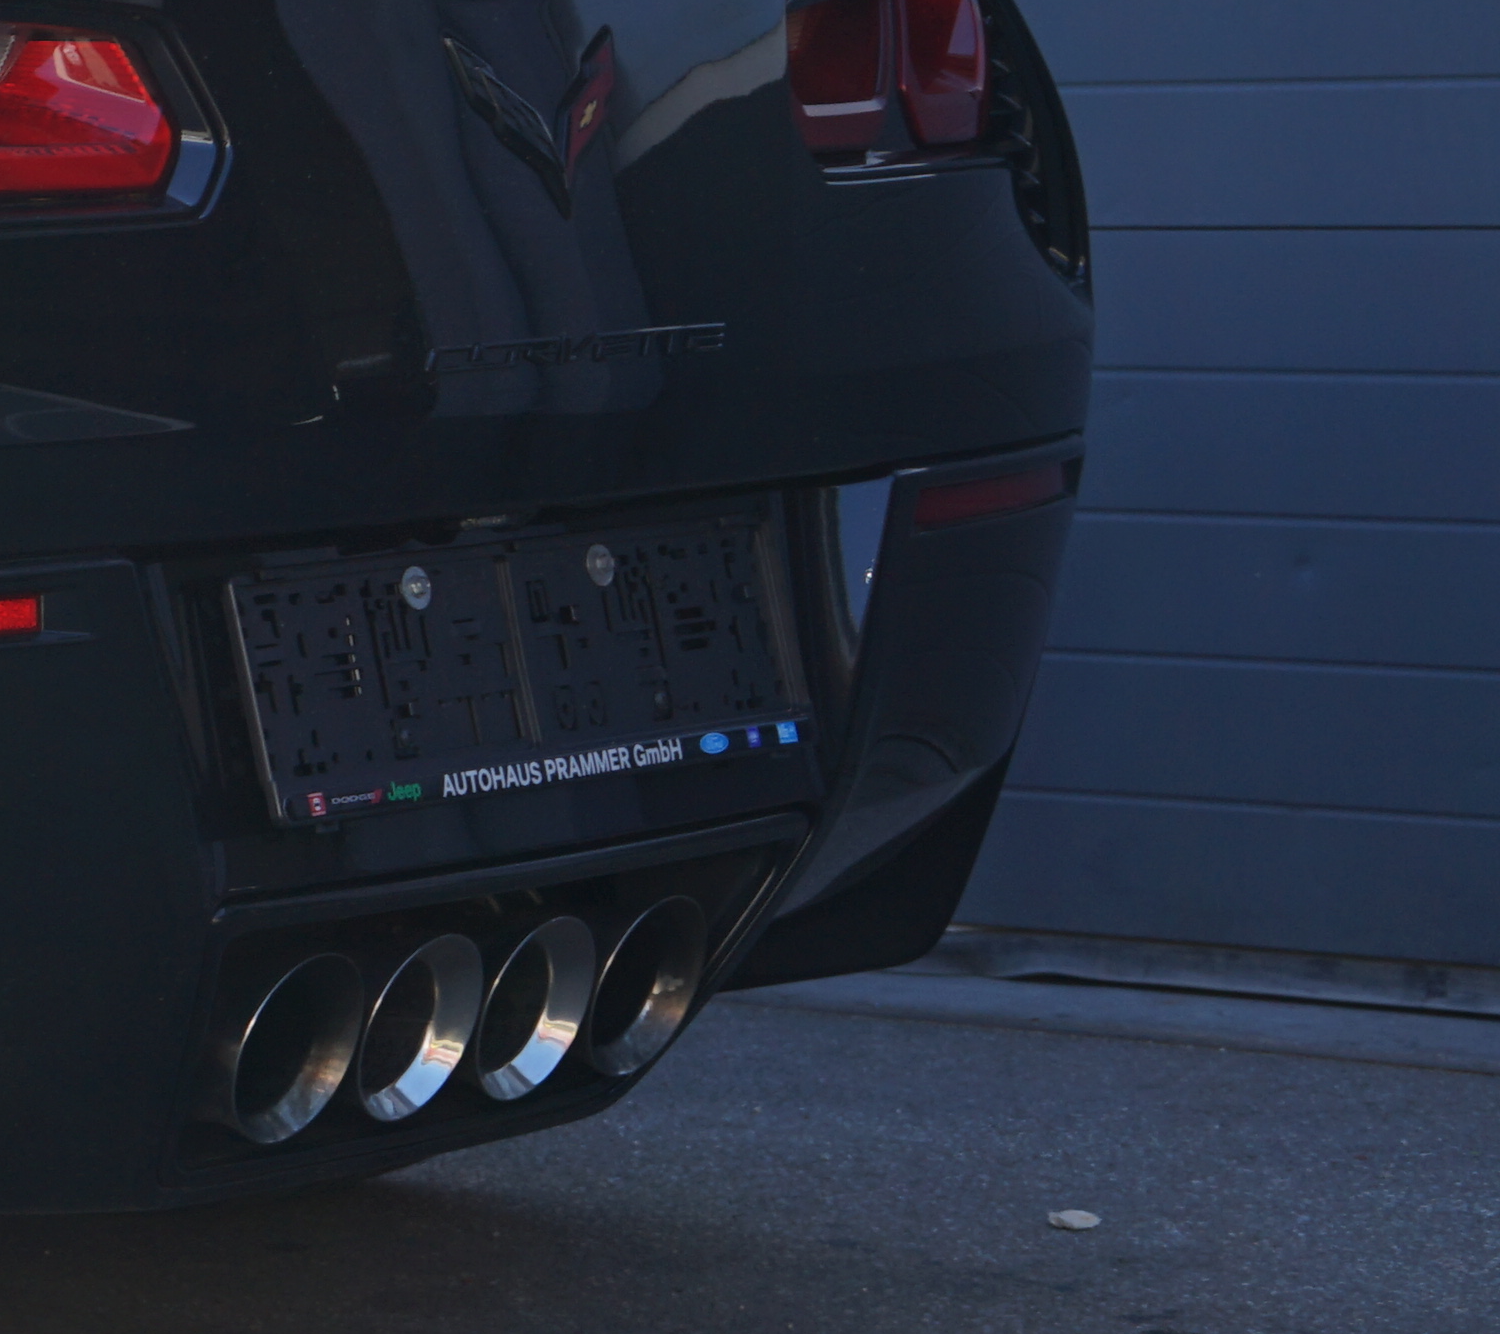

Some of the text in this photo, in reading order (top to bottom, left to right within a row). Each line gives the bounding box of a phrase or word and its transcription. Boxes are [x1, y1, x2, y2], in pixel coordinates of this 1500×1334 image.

[442, 764, 542, 798] AUTOHAUS
[544, 747, 631, 782] PRAMMER
[633, 738, 683, 767] GmbH
[331, 793, 376, 805] DODGE
[387, 781, 422, 802] Jeep
